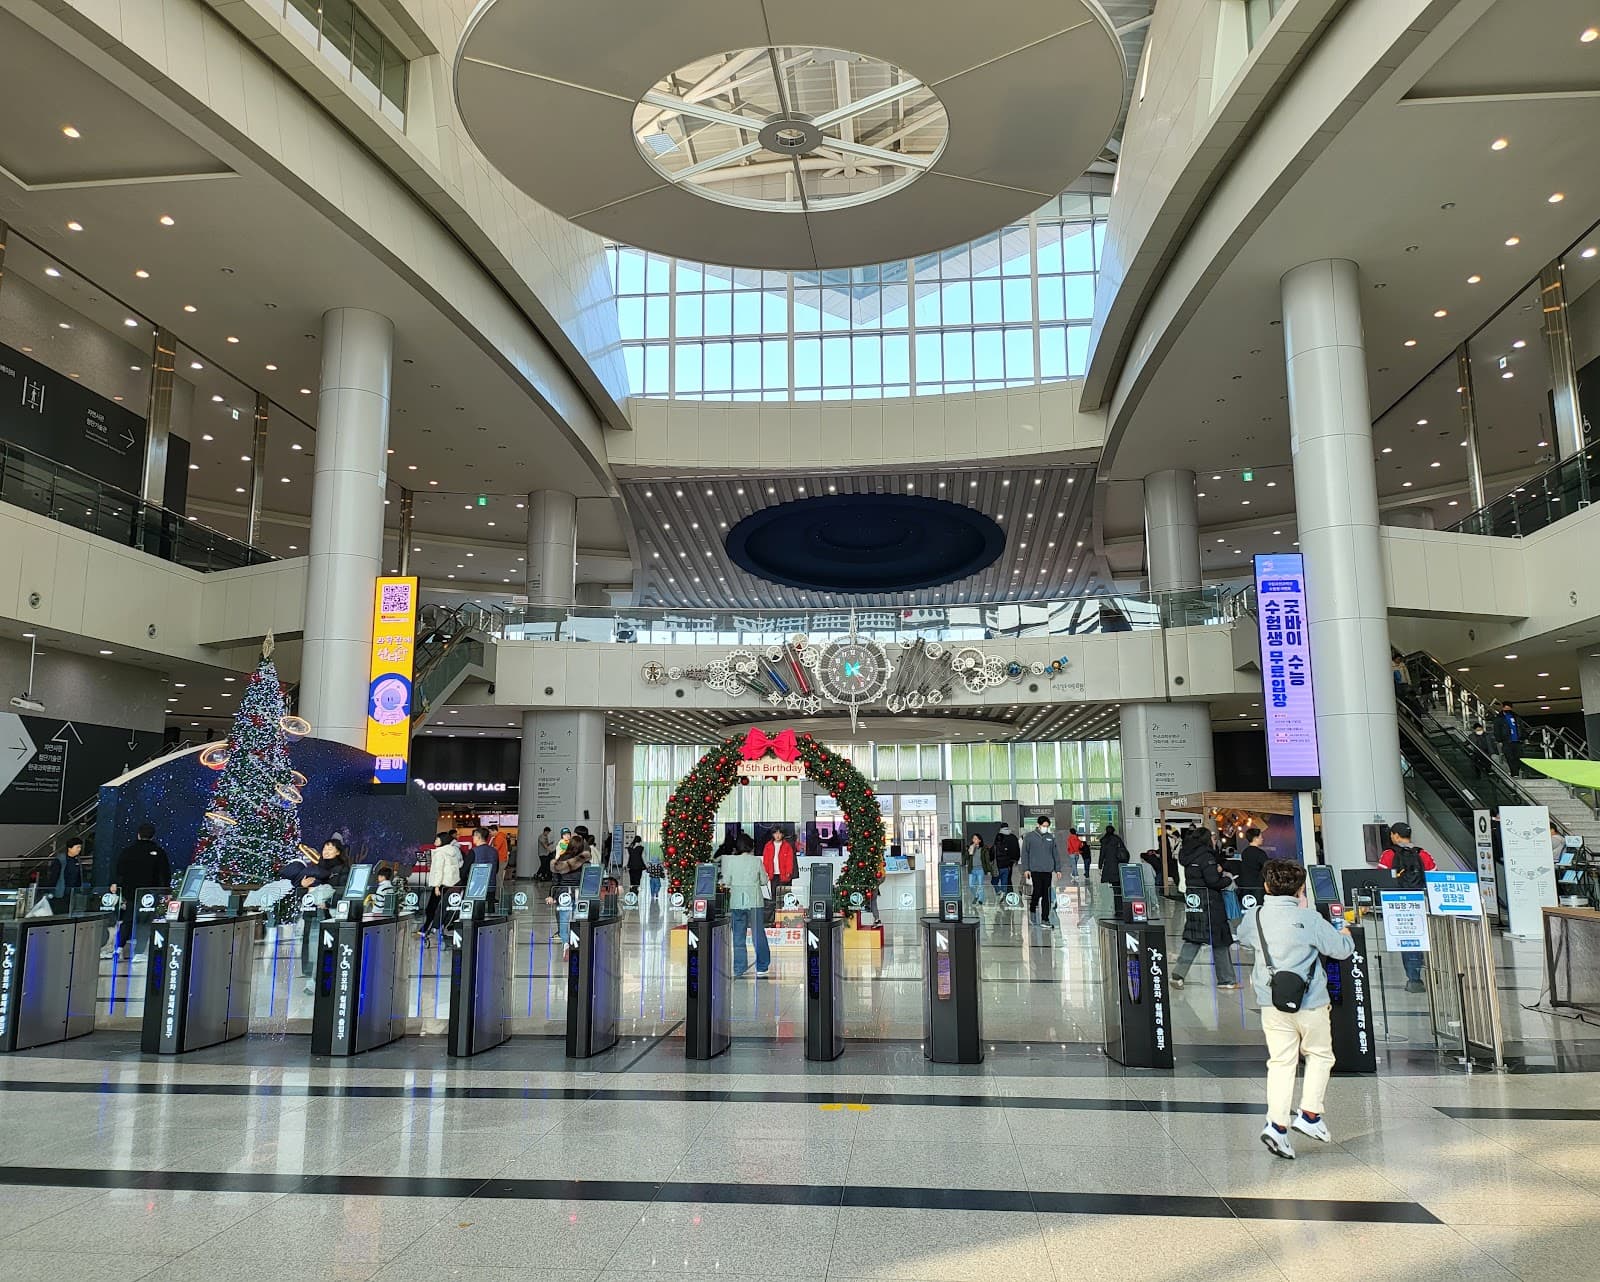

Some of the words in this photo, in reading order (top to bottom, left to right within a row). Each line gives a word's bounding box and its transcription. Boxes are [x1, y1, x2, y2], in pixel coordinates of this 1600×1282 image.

[1265, 600, 1283, 646] 수험생
[1284, 600, 1301, 646] 굿바이
[1288, 655, 1304, 686] 수능
[1270, 651, 1287, 708] 무료입장
[763, 764, 802, 773] Birthday
[427, 783, 474, 791] GOURMET
[477, 783, 506, 791] PLACE
[1434, 884, 1471, 893] 상설전시관
[1442, 894, 1465, 903] 입장권
[786, 930, 800, 940] 15
